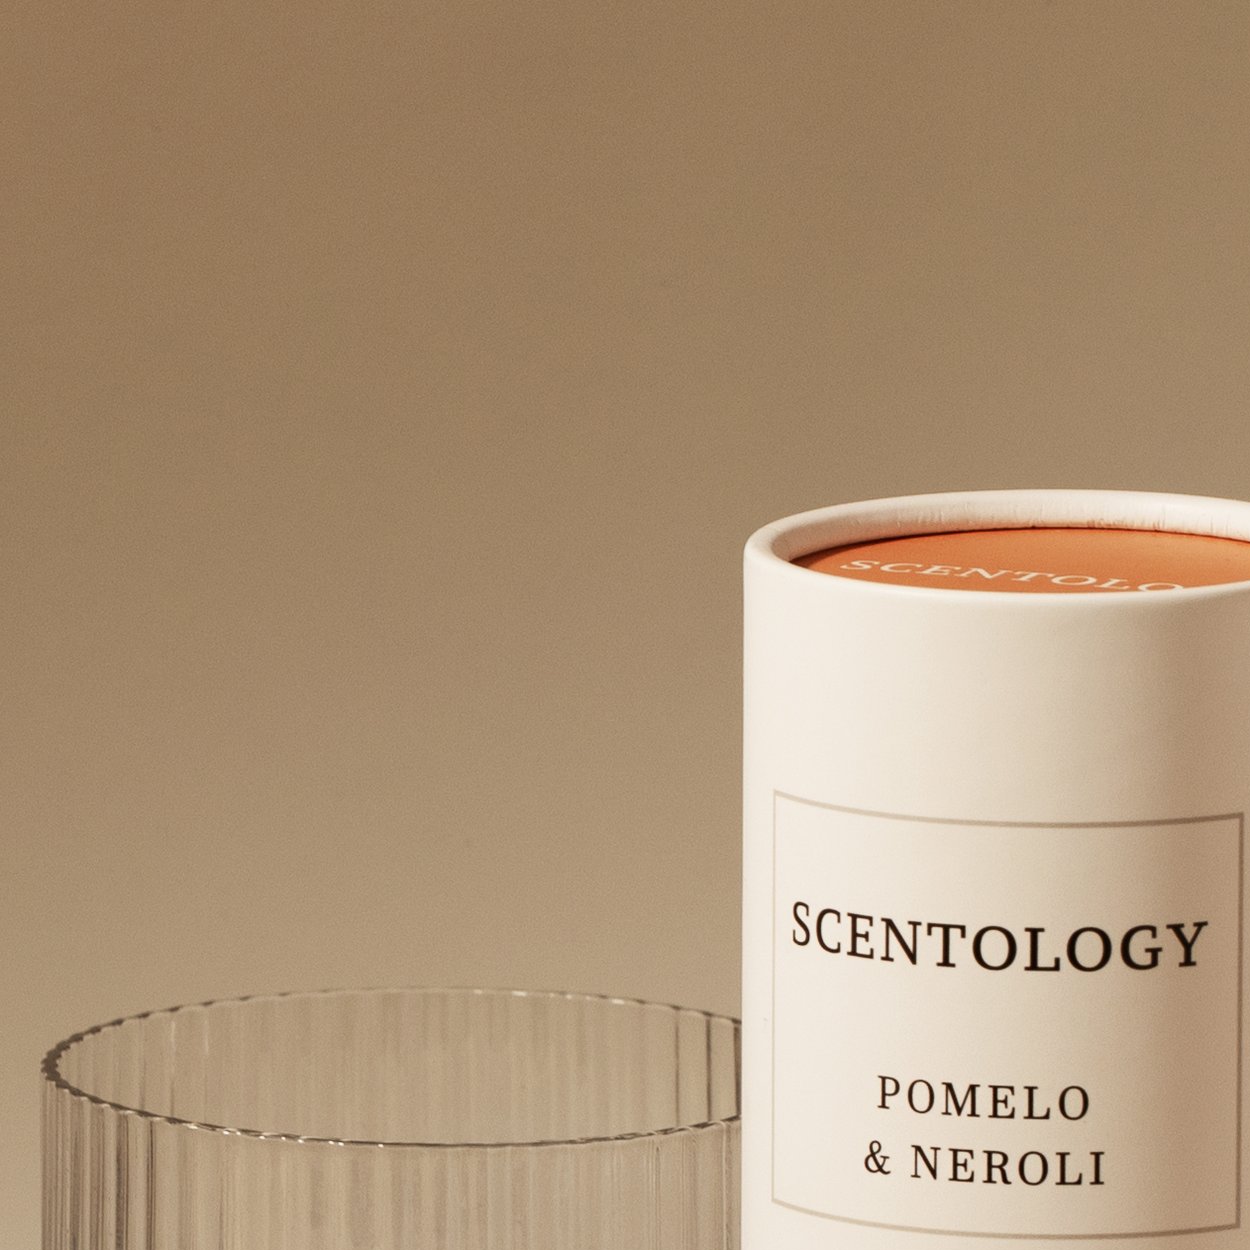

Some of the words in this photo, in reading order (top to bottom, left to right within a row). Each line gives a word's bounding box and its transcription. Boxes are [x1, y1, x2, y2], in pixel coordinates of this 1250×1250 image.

[792, 901, 1208, 972] SCENTOLOGY
[877, 1075, 1090, 1121] POMELO
[863, 1139, 891, 1175] &
[910, 1144, 1106, 1186] NEROLI
